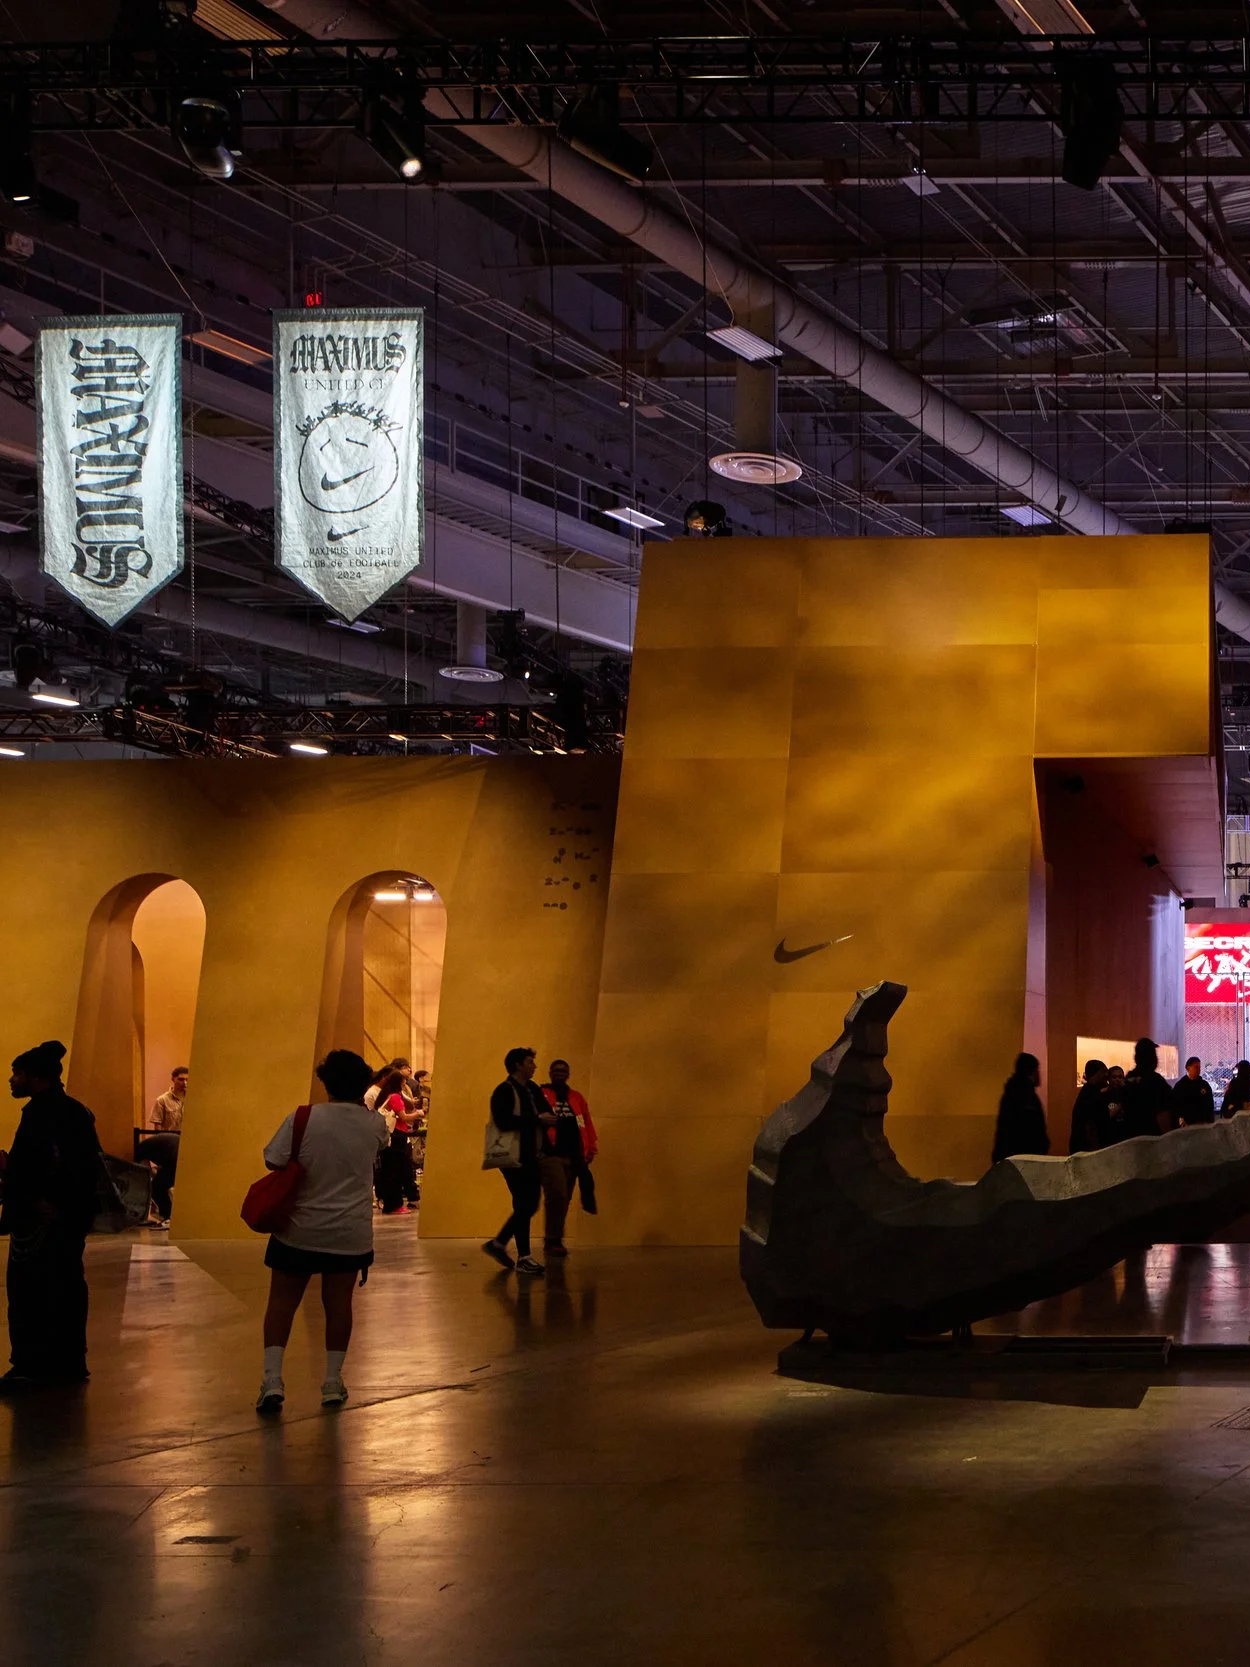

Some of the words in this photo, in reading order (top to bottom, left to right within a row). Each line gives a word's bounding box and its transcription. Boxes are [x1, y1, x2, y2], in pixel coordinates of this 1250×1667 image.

[290, 332, 406, 374] MAXIMUS
[304, 378, 364, 391] UNITED
[70, 339, 153, 588] MAXIMUS
[308, 546, 349, 556] MAXIMUS
[355, 546, 394, 556] UNITED
[303, 559, 326, 569] CLUB
[331, 559, 343, 568] de
[337, 570, 361, 579] 2024
